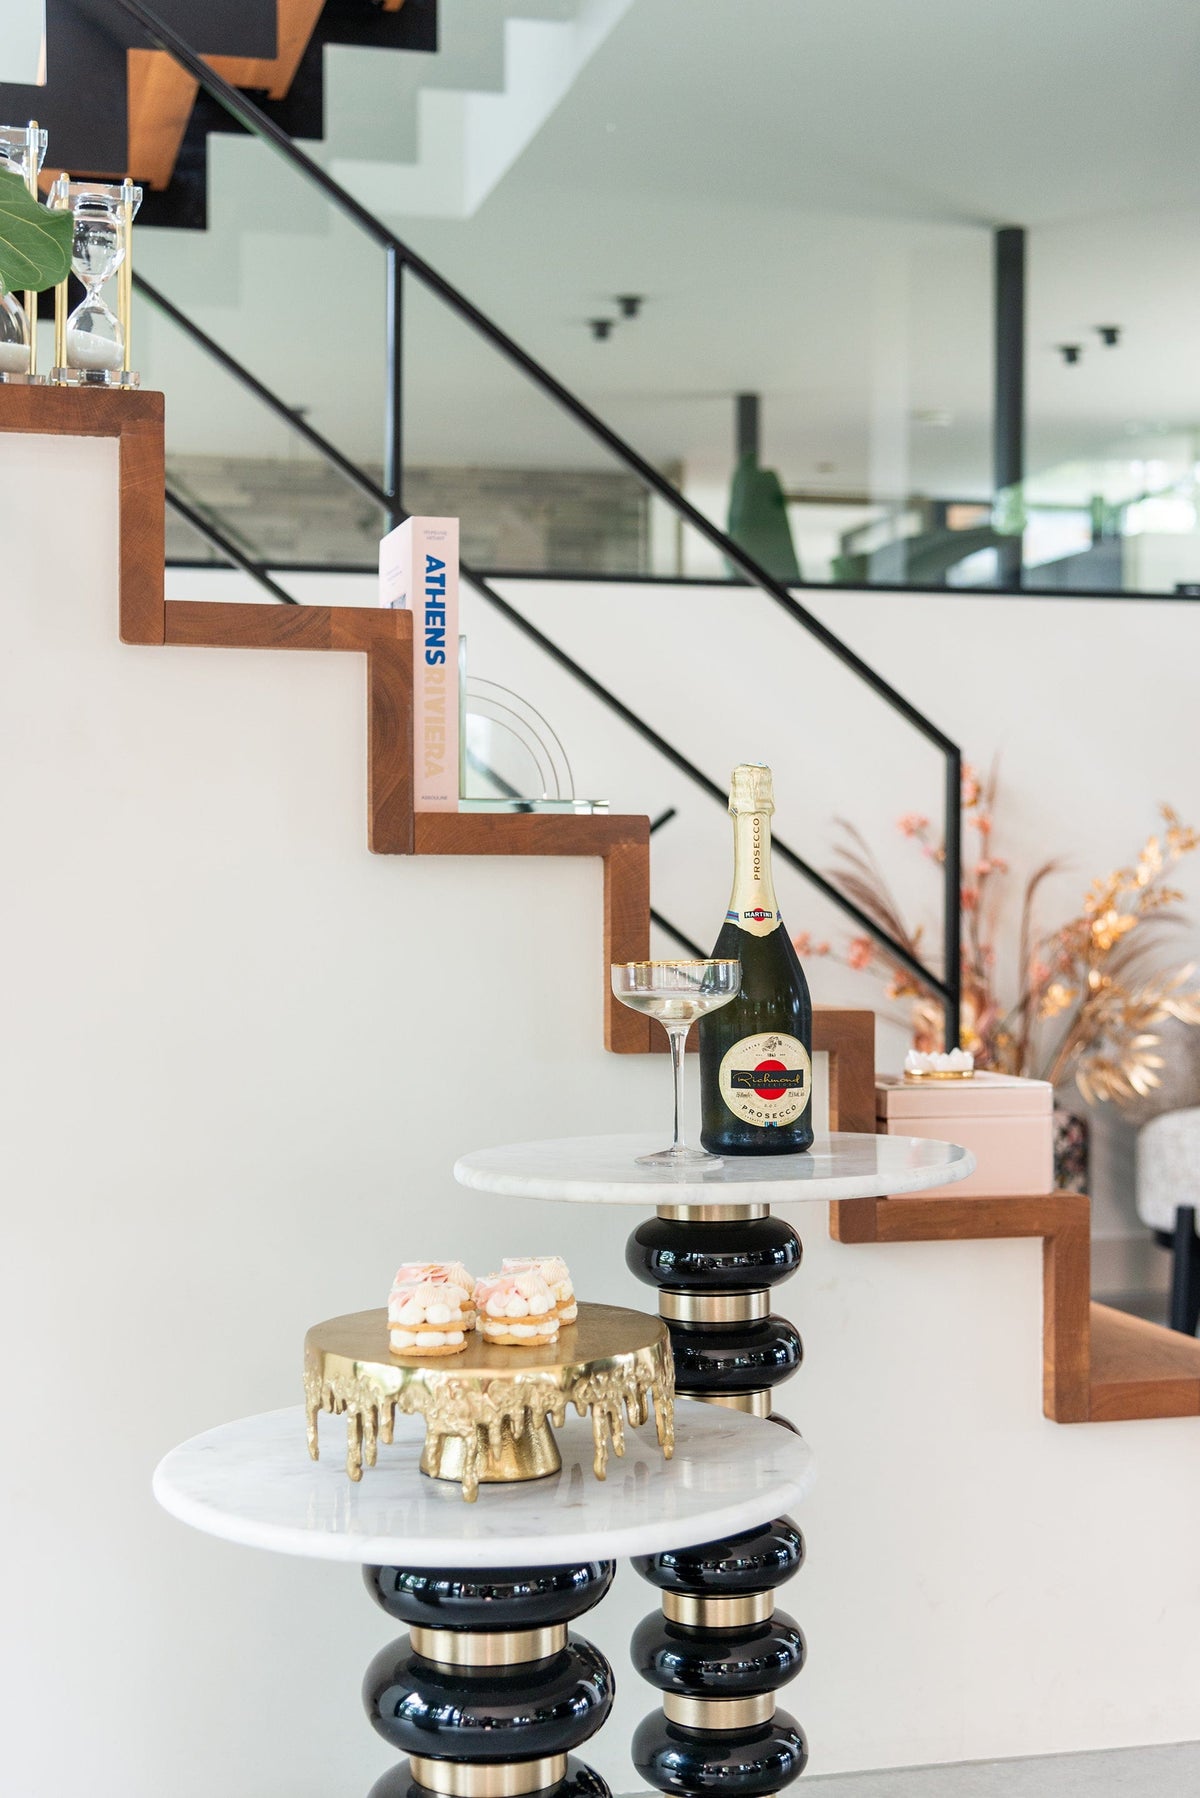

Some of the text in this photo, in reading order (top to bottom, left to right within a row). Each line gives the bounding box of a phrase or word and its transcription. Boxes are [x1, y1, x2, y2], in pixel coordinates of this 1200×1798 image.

[424, 554, 446, 665] ATHENS
[424, 667, 446, 778] RIVIERA
[752, 817, 761, 881] PROSECCO
[745, 911, 772, 919] MARTINI
[733, 1071, 801, 1088] Richmond
[741, 1104, 797, 1119] PROSECCO
